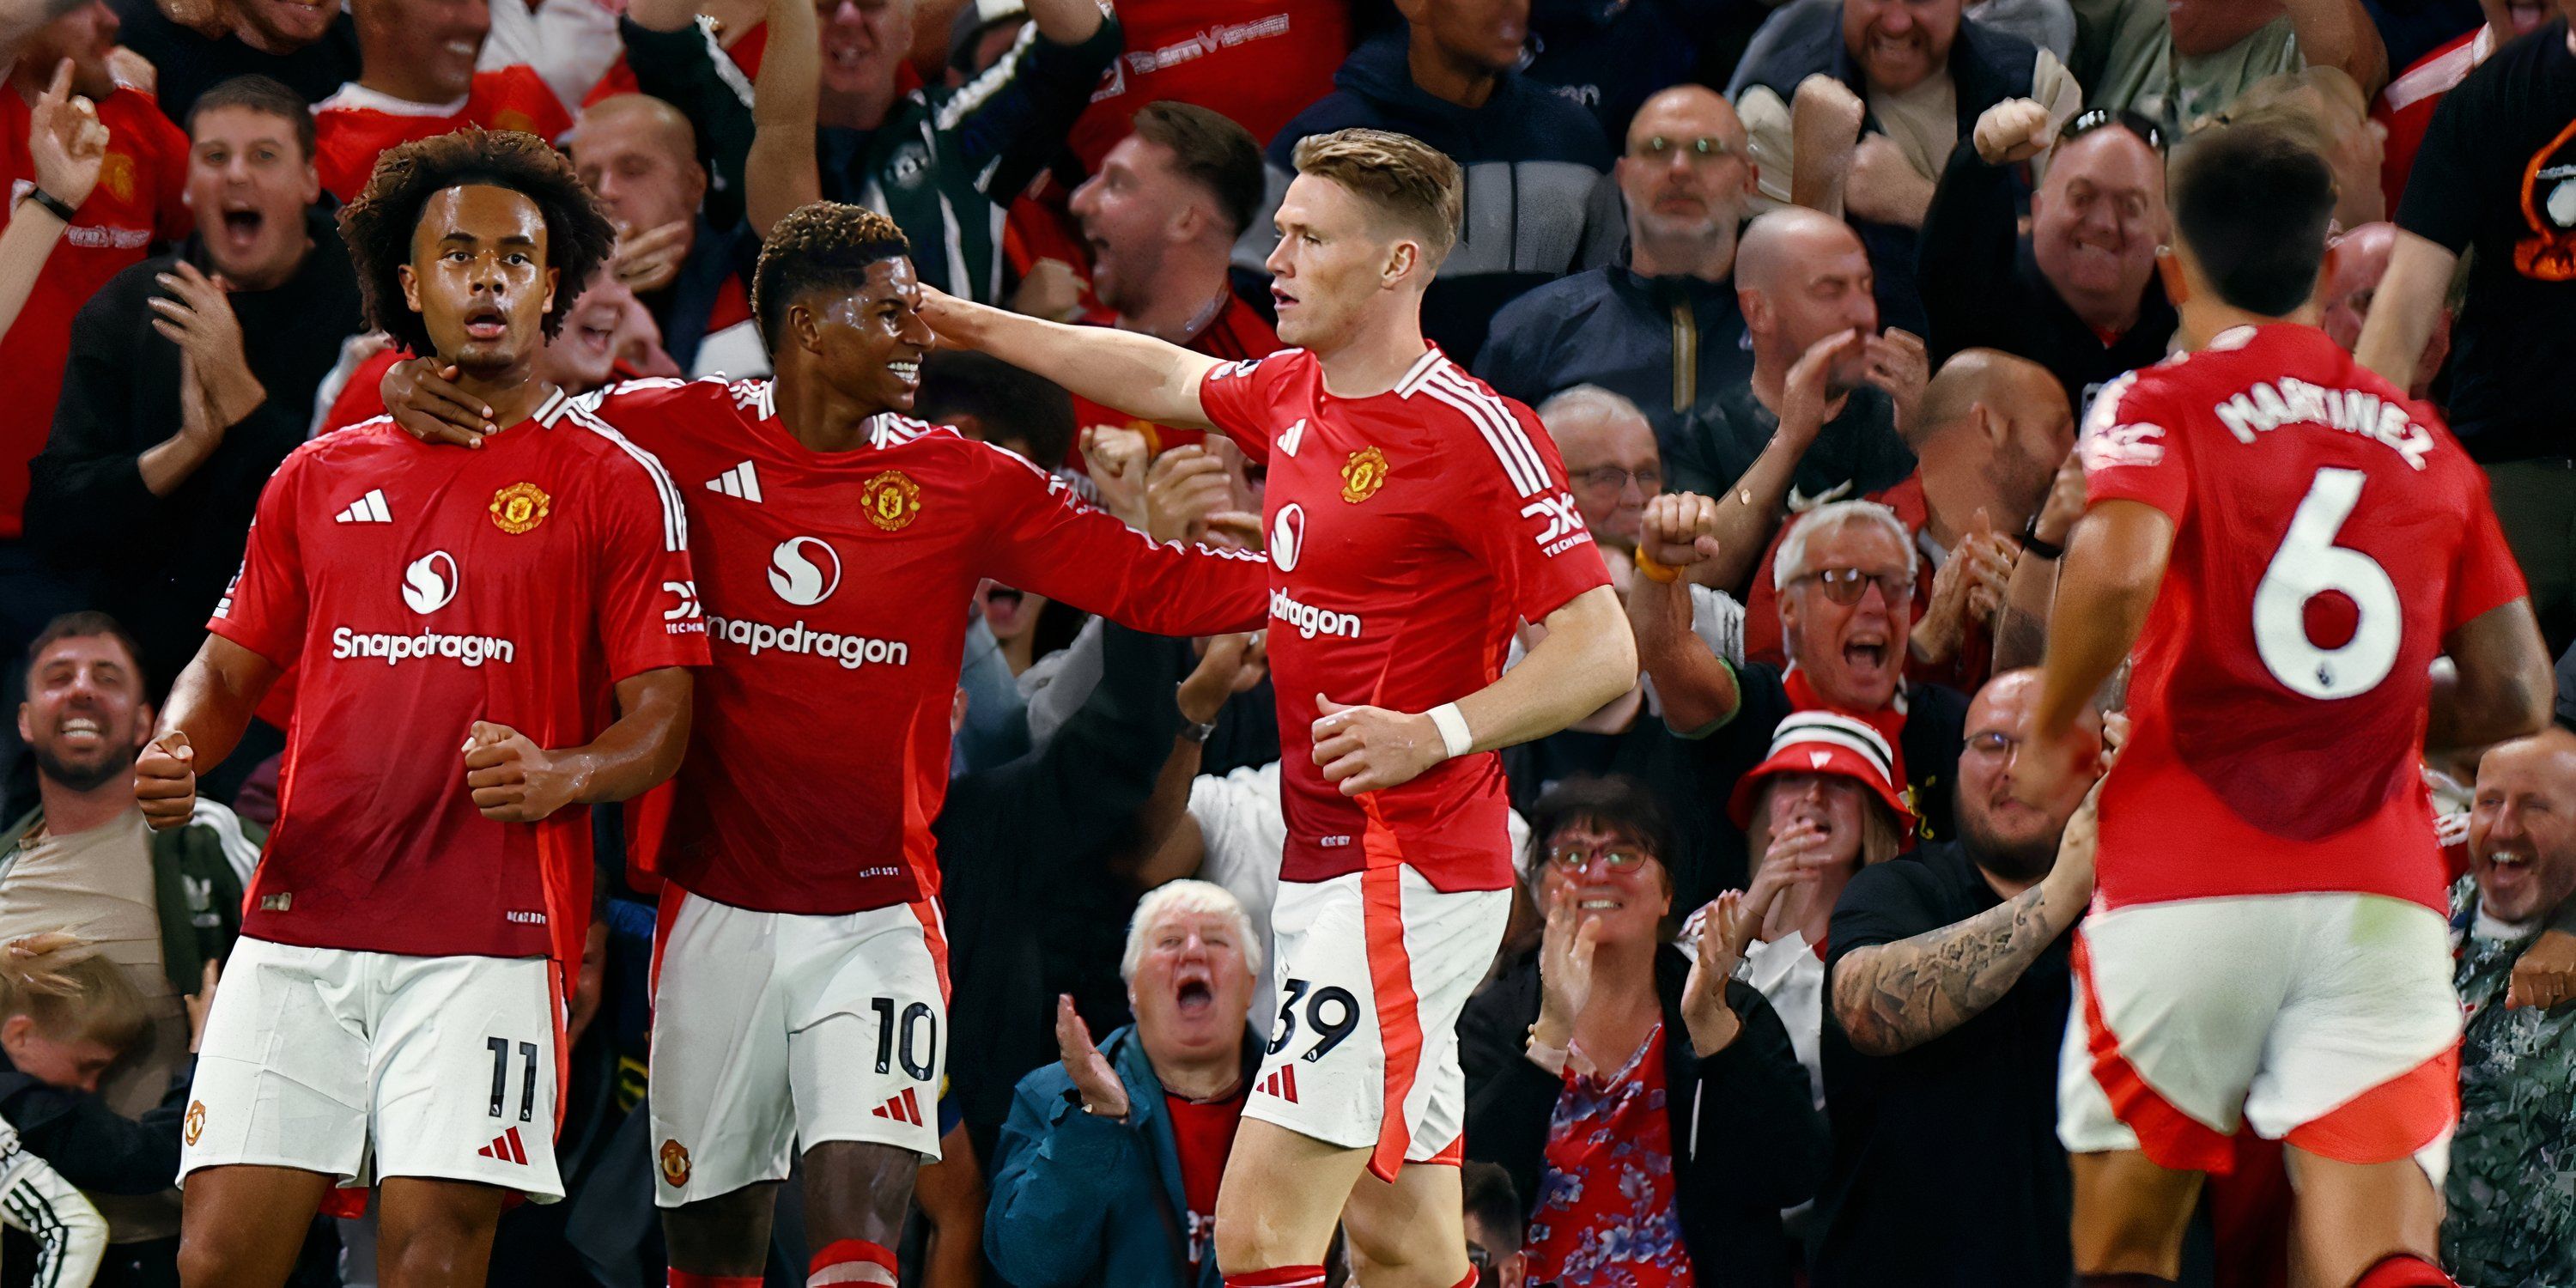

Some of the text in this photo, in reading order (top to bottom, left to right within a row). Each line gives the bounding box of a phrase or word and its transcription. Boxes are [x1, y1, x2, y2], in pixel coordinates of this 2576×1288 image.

[2214, 375, 2435, 471] MARTINEZ
[1270, 586, 1361, 640] dragon
[2252, 465, 2402, 701] 6
[332, 626, 514, 667] Snapdragon
[706, 614, 908, 670] napdragon
[871, 997, 937, 1082] 10
[1266, 978, 1360, 1063] 39
[486, 1036, 538, 1122] 11
